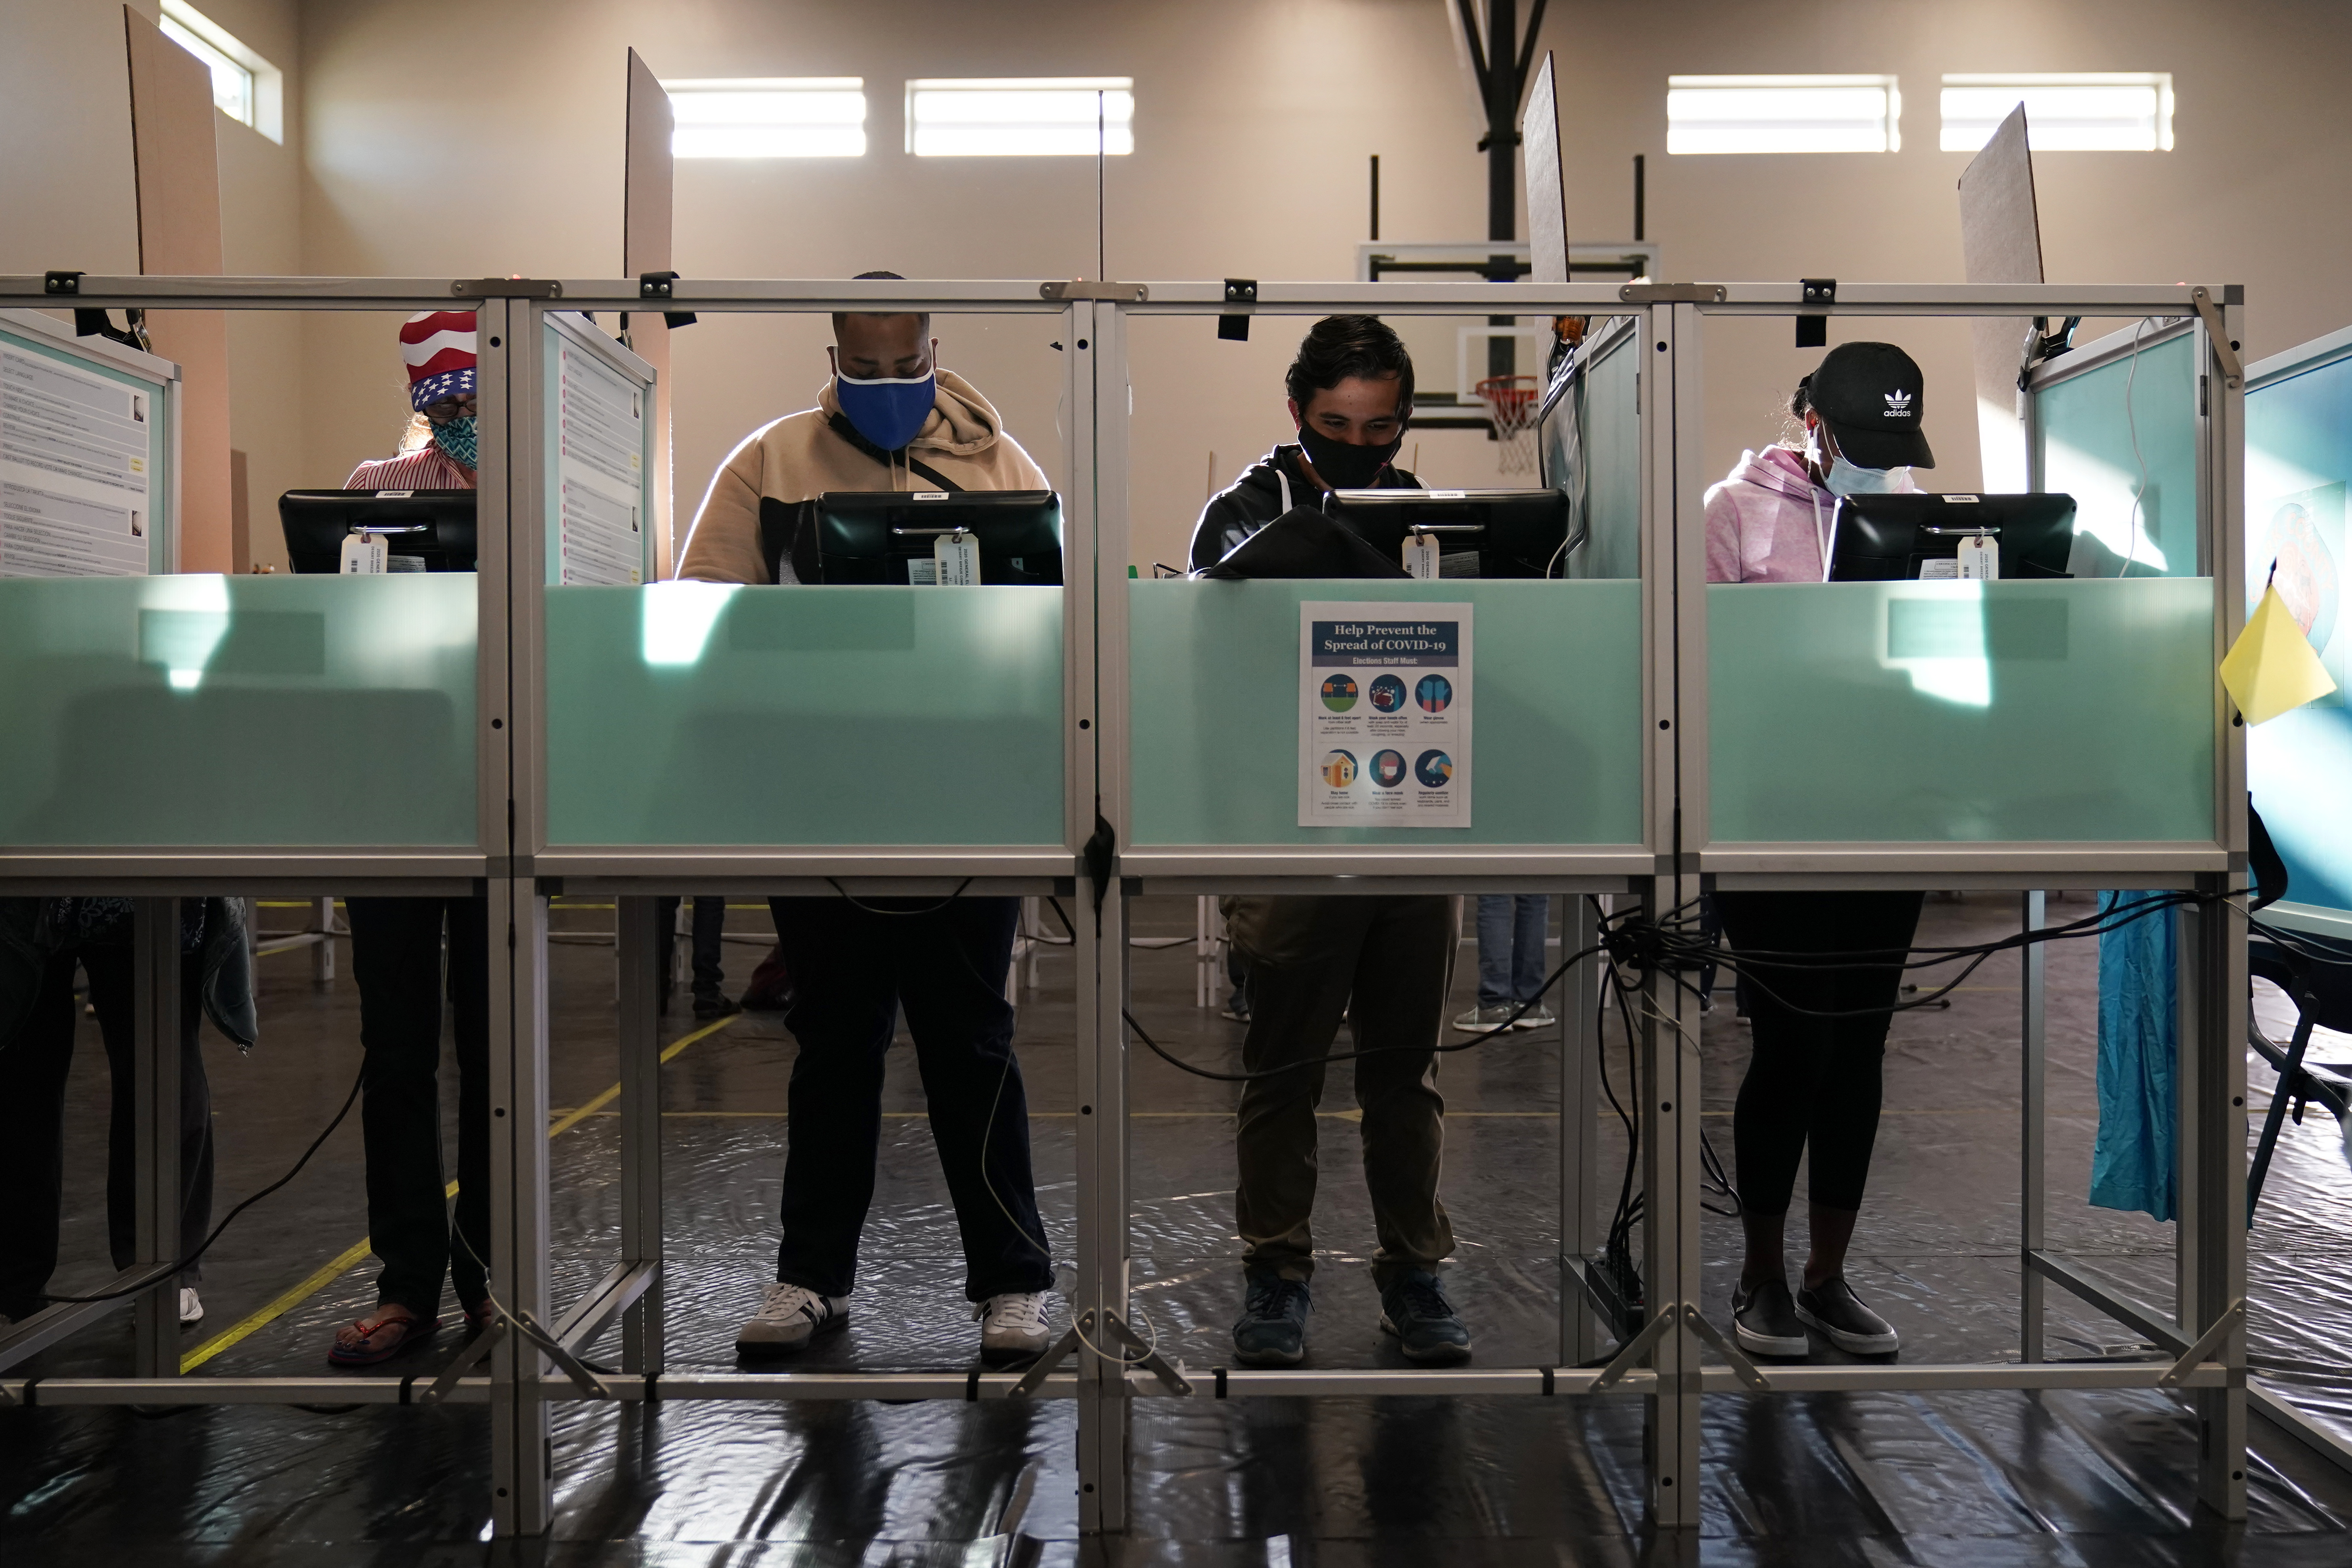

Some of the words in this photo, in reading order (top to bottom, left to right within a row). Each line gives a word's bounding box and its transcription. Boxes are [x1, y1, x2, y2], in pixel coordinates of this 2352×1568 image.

[2249, 521, 2283, 603] CLARK
[2287, 513, 2334, 591] COUNTY
[1335, 625, 1364, 637] Help
[1367, 625, 1414, 635] Prevent
[1417, 625, 1436, 635] the
[1325, 640, 1368, 652] Spread
[1371, 640, 1384, 650] of
[1386, 641, 1446, 651] COVID-19
